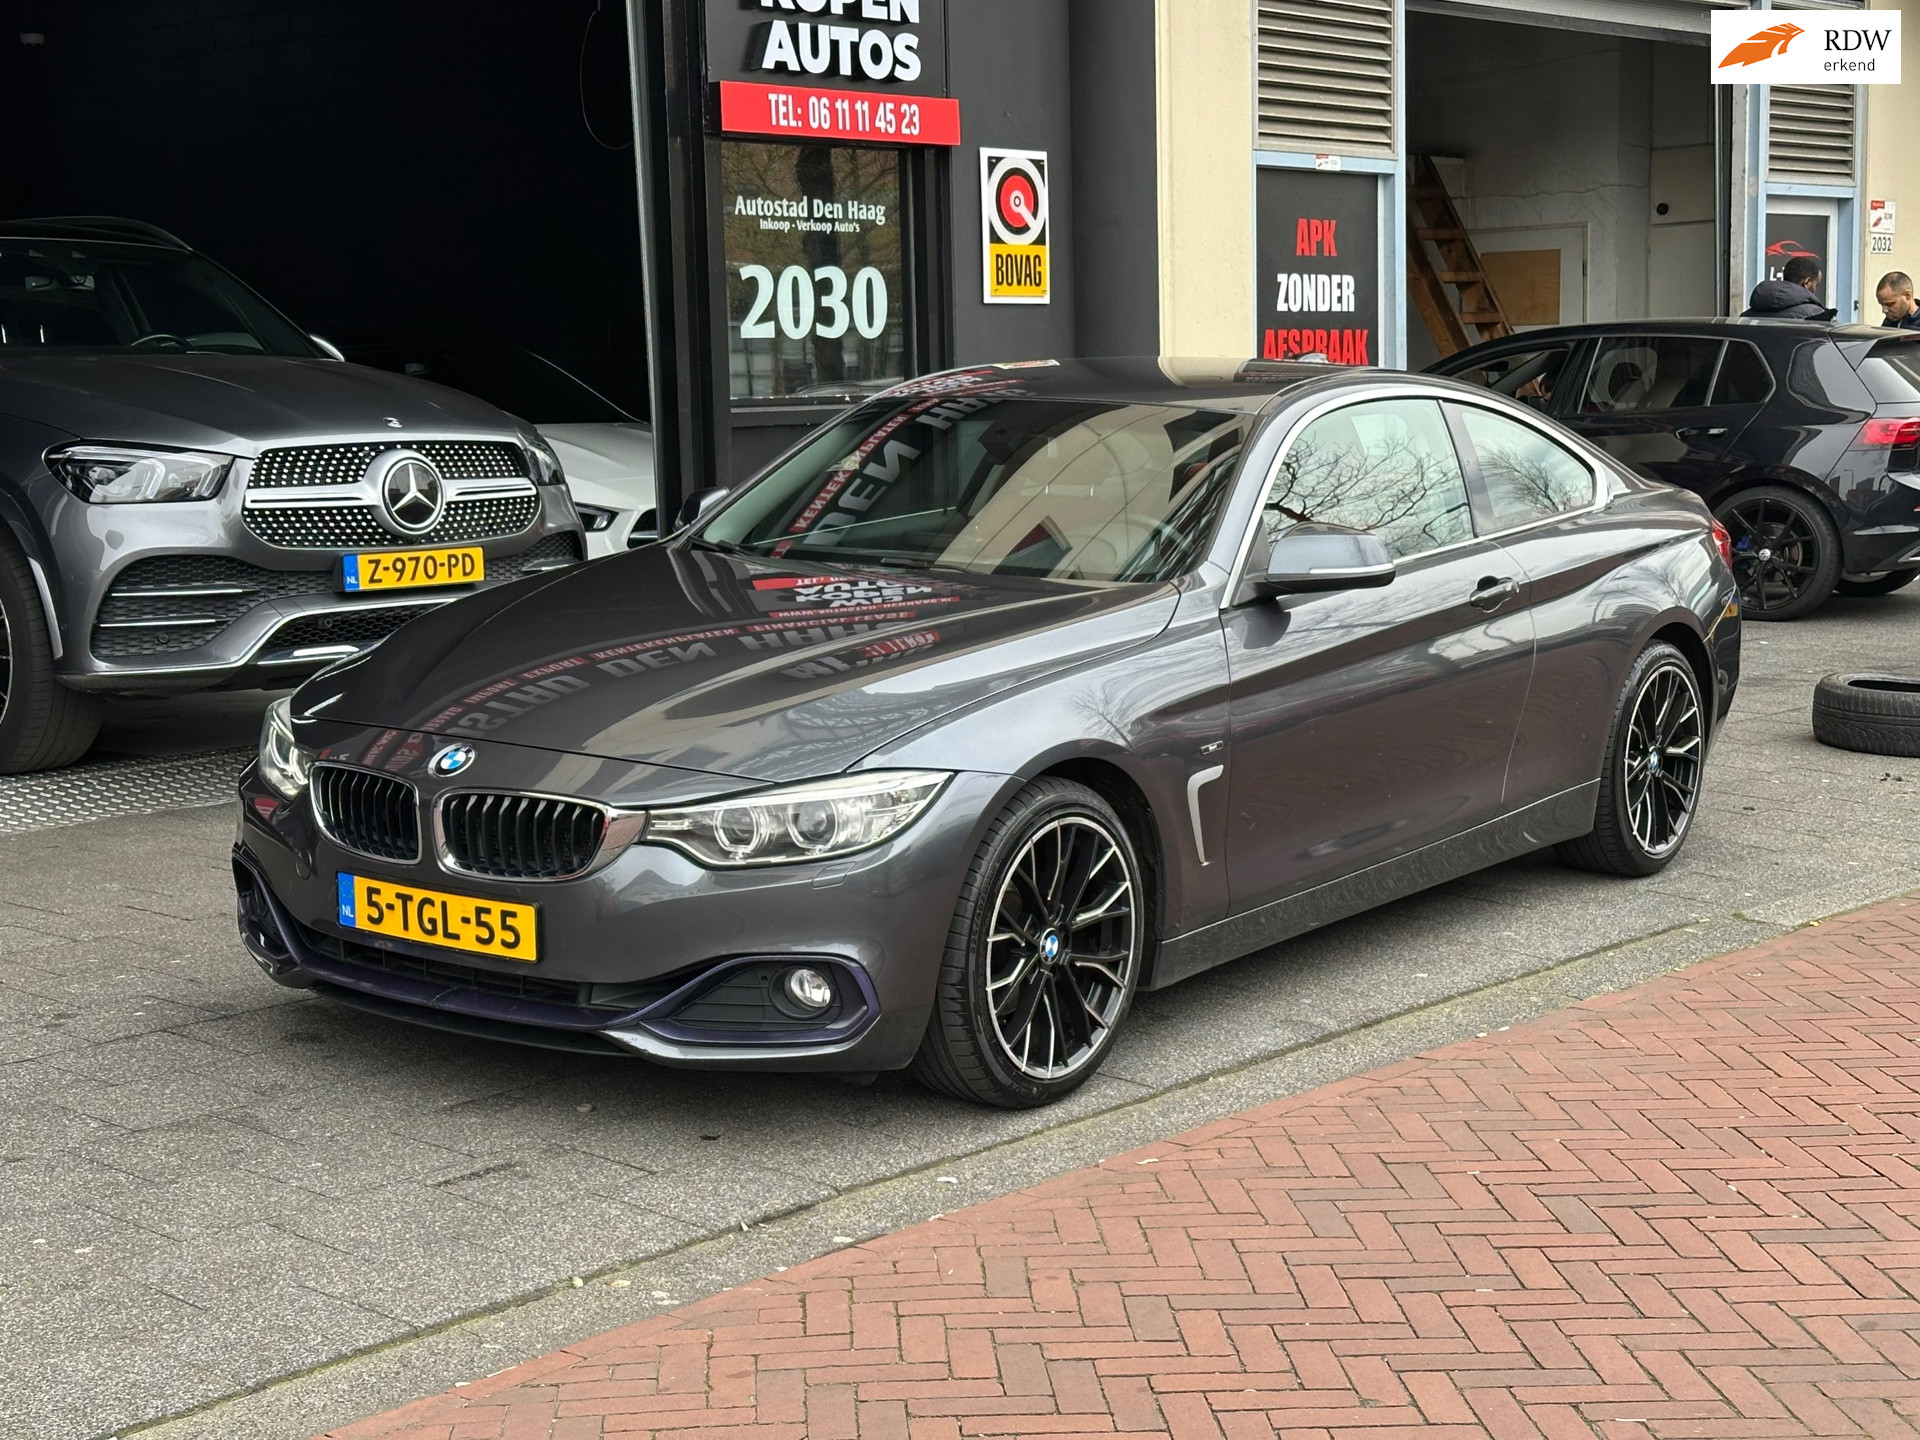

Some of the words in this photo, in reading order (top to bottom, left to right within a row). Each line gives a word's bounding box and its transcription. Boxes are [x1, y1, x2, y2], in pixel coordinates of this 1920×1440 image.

[761, 19, 921, 82] AUTOS
[768, 93, 802, 127] TEL:
[808, 96, 830, 130] 06
[835, 99, 850, 131] 11
[855, 100, 870, 132] 11
[875, 102, 896, 134] 45
[901, 104, 920, 135] 23
[734, 195, 808, 218] Autostad
[813, 199, 843, 219] Den
[847, 201, 886, 225] Haag
[760, 218, 790, 233] Inkoop
[796, 219, 832, 234] Verkoop
[834, 221, 860, 233] Auto's
[1296, 218, 1337, 256] APK
[1872, 236, 1892, 252] 2032
[995, 253, 1042, 287] BOVAG
[739, 264, 888, 340] 2030
[1276, 273, 1355, 312] ZONDER
[346, 576, 358, 585] NL
[368, 553, 475, 584] Z-970-PD
[342, 905, 354, 918] NL
[366, 886, 521, 949] 5-TGL-55
